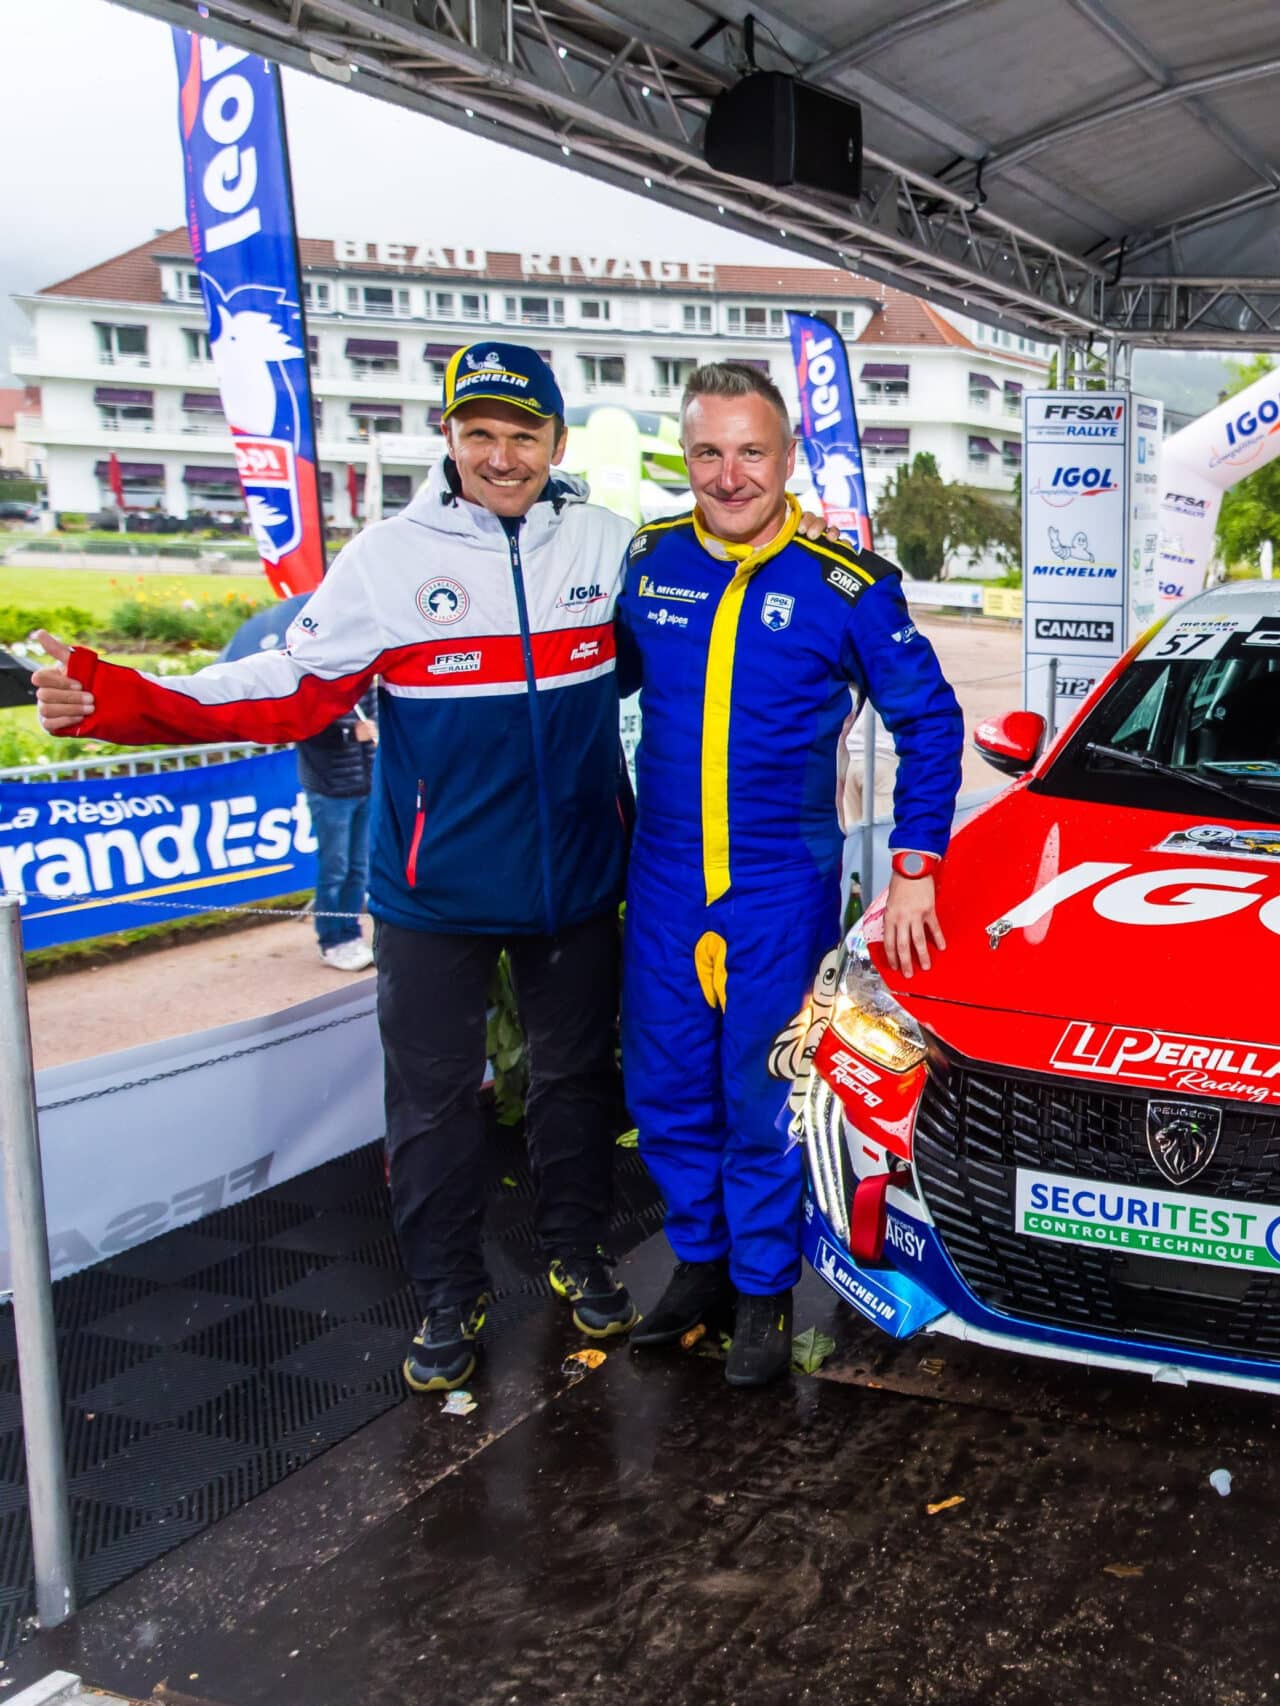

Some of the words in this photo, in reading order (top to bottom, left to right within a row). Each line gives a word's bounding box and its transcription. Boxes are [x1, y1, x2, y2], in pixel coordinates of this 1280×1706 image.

[334, 240, 487, 271] BEAU
[520, 247, 716, 283] RIVAGE
[456, 373, 529, 392] MICHELIN
[1044, 405, 1113, 420] FFSA
[1066, 426, 1118, 437] RALLYE
[1052, 467, 1112, 488] IGOL
[1164, 493, 1206, 508] FFSA
[829, 570, 861, 592] OMP
[1033, 565, 1118, 579] MICHELIN
[570, 584, 603, 601] IGOL
[656, 585, 710, 600] MICHELIN
[1036, 620, 1113, 640] CANAL+
[1181, 620, 1239, 628] message
[1156, 633, 1216, 657] 57
[436, 652, 474, 664] FFSA
[448, 663, 478, 671] RALLYE
[49, 792, 175, 826] Région
[1201, 829, 1222, 838] 57
[829, 1049, 883, 1085] 208
[830, 1066, 883, 1108] Racing
[1169, 1069, 1270, 1102] Racing
[1152, 1106, 1216, 1121] PEUGEOT
[1030, 1183, 1257, 1240] SECURITEST
[885, 1225, 926, 1262] ARSY
[1028, 1217, 1130, 1244] CONTROLE
[1138, 1234, 1255, 1261] TECHNIQUE
[834, 1265, 896, 1321] MICHELIN
